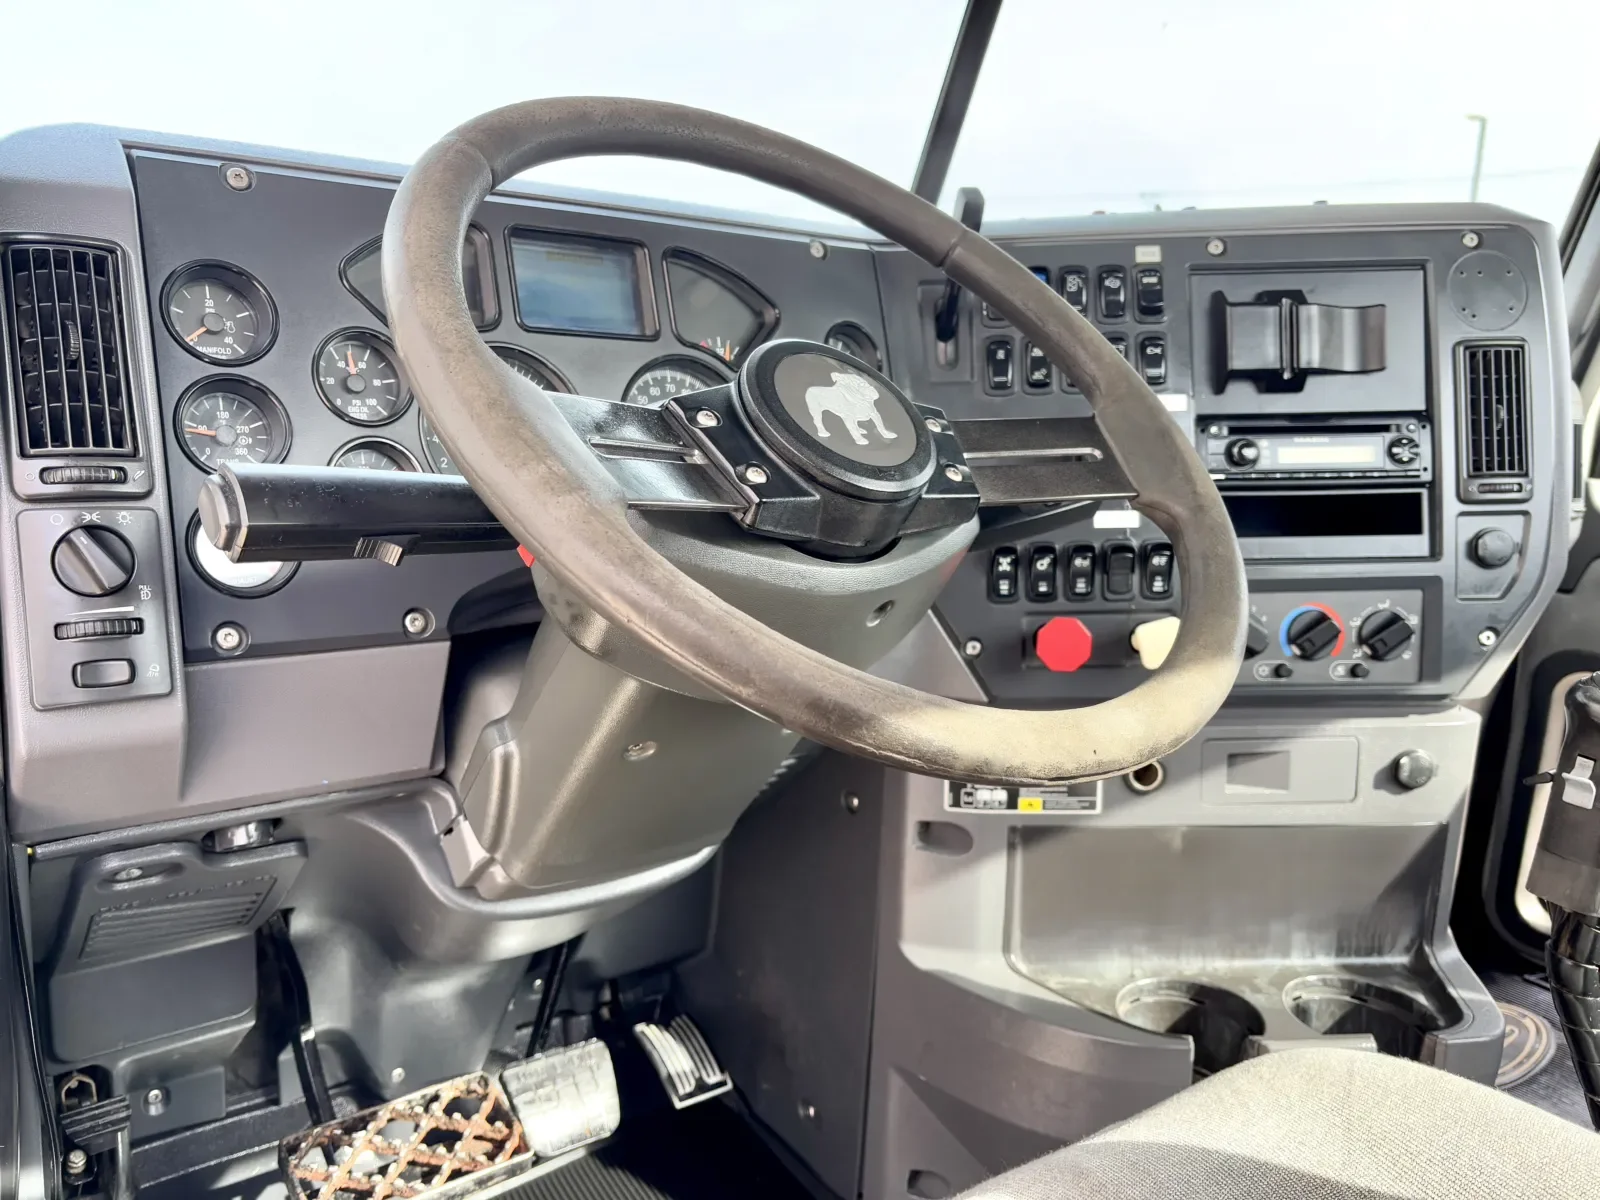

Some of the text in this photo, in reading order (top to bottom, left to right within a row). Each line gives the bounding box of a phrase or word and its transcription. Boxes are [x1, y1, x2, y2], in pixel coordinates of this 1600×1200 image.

[204, 299, 214, 307] 20
[223, 336, 234, 345] 40
[196, 346, 232, 354] MANIFOLD
[337, 360, 346, 368] 40
[326, 377, 335, 385] 20
[373, 379, 382, 387] 80
[649, 387, 661, 397] 60
[665, 384, 676, 393] 70
[336, 398, 342, 406] 0
[637, 396, 649, 405] 50
[216, 411, 230, 419] 180
[236, 425, 250, 434] 270
[205, 447, 211, 455] 0
[235, 447, 248, 456] 360
[440, 457, 448, 468] 2
